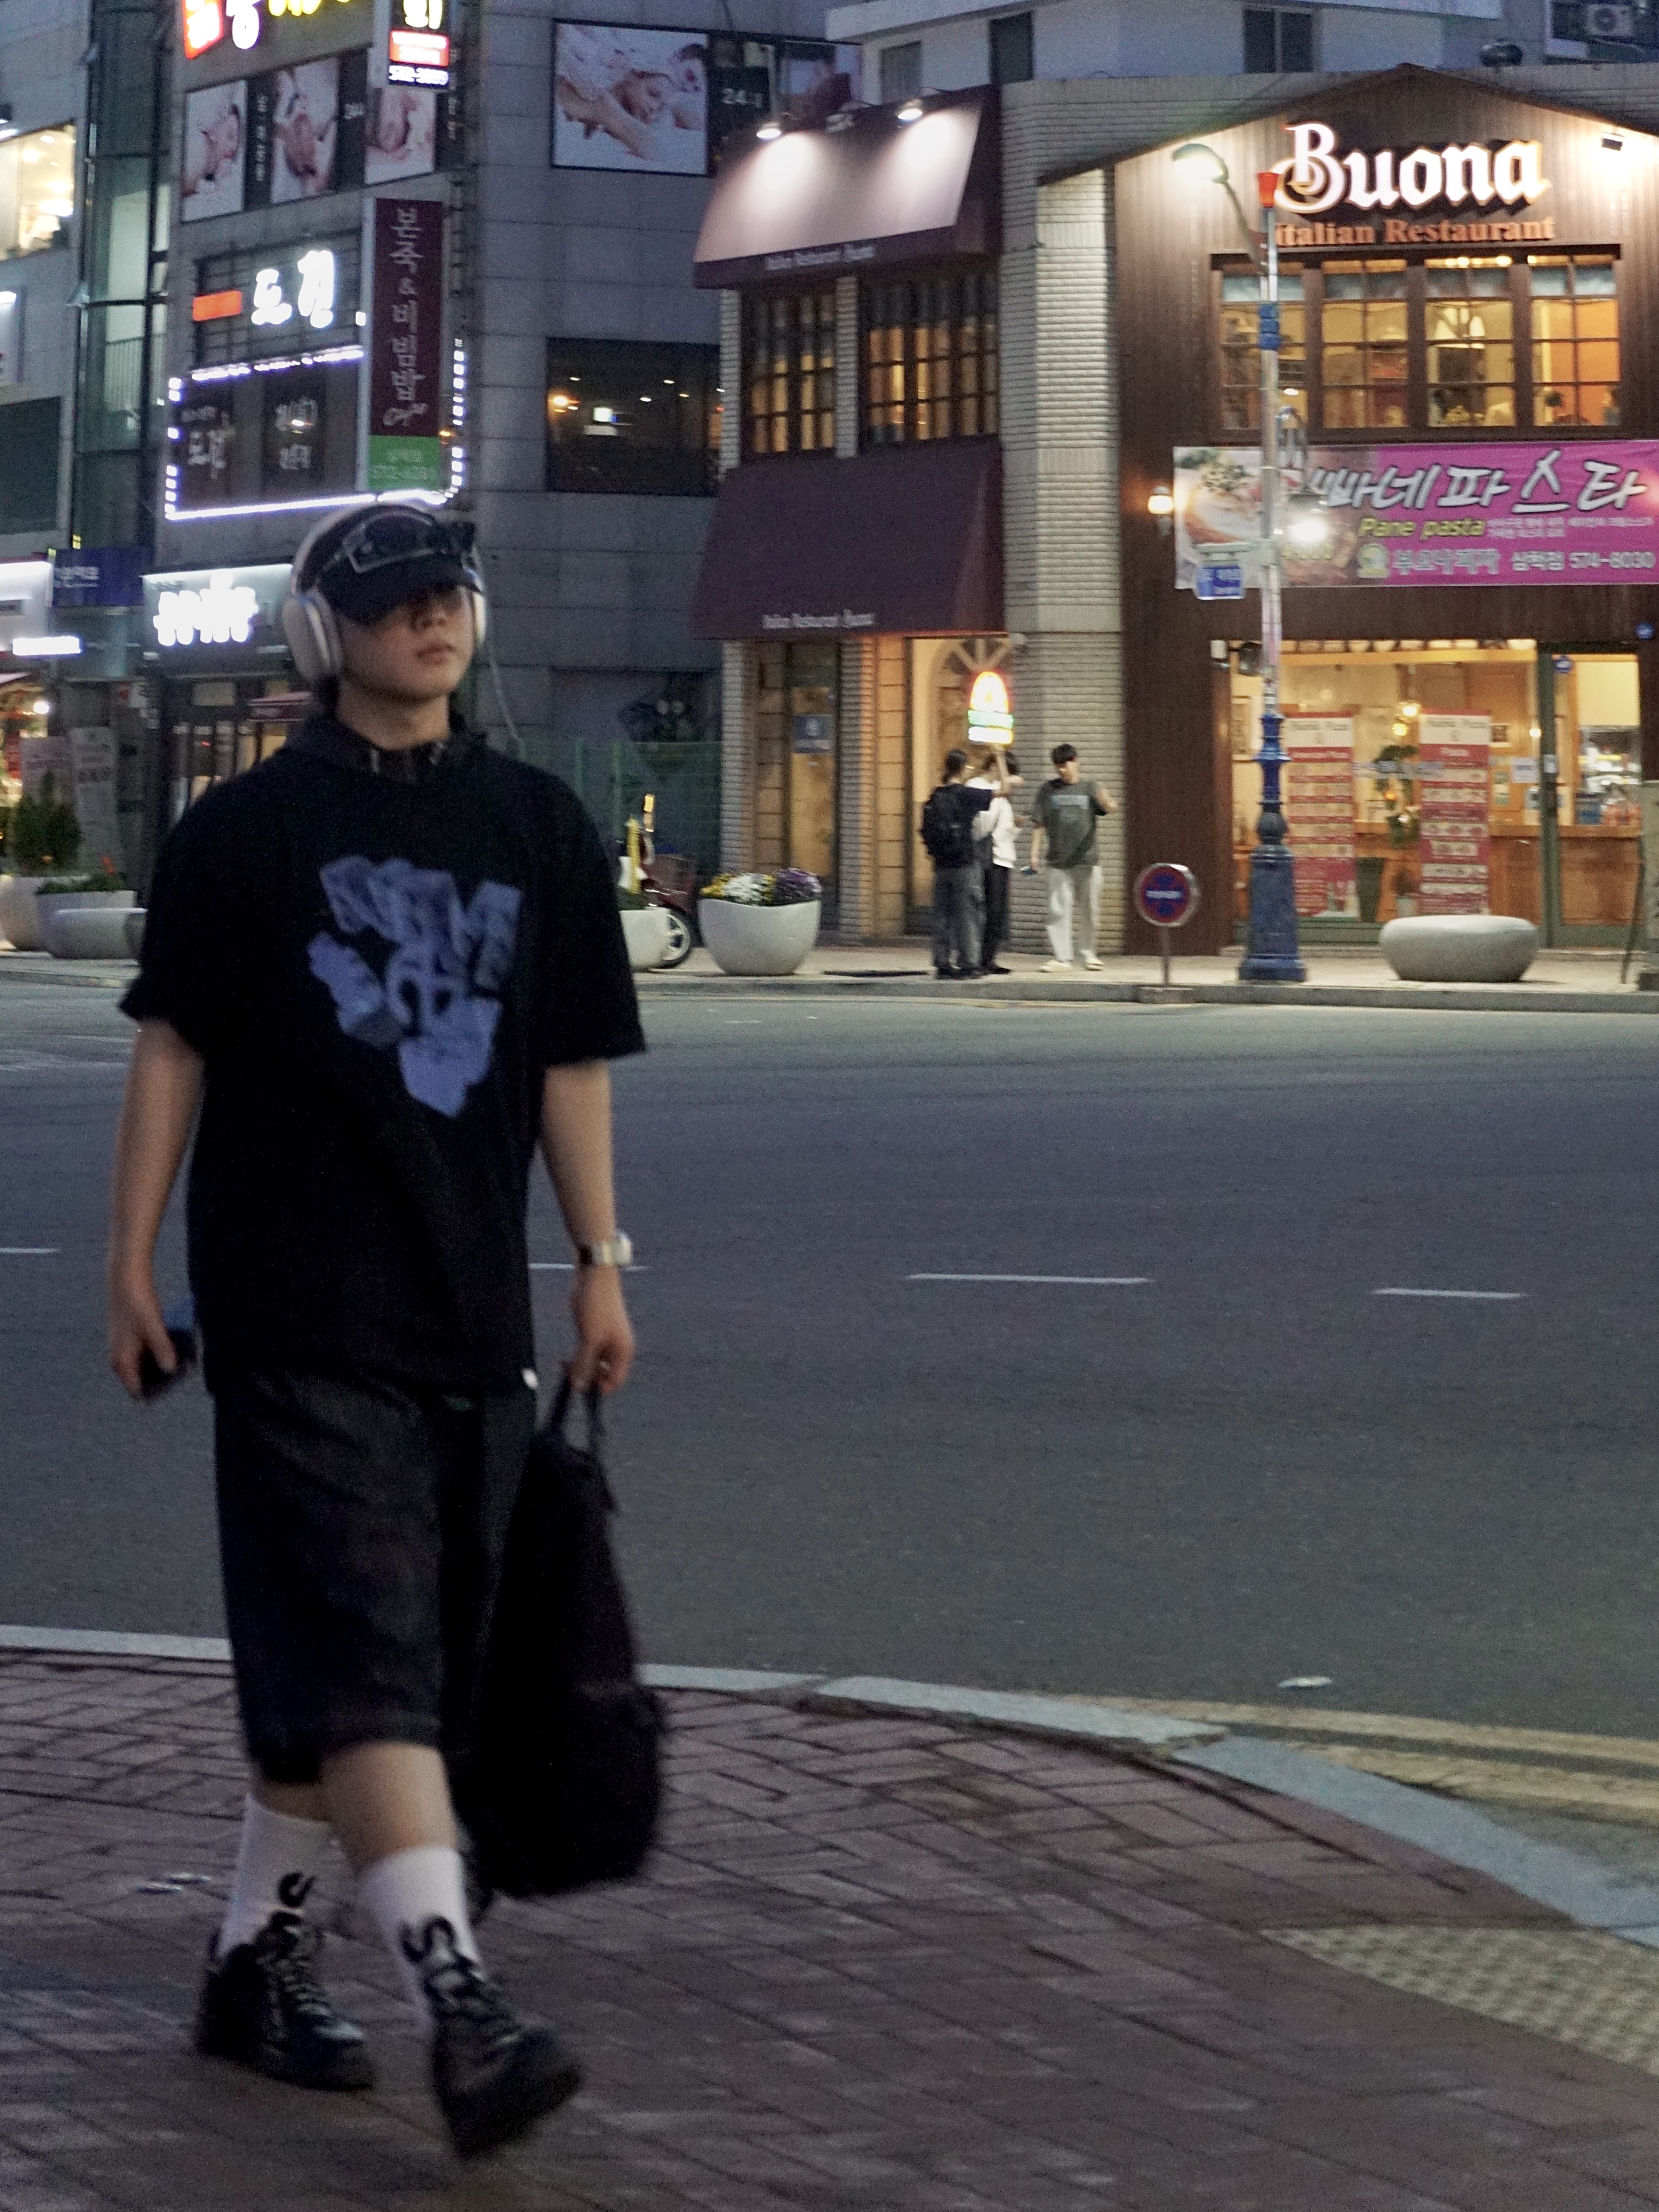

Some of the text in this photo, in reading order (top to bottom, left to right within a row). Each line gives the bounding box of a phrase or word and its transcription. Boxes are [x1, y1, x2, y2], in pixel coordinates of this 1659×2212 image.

[1270, 121, 1552, 215] Buona
[1275, 217, 1555, 246] Italian Restaurant
[1357, 517, 1415, 537] Pane
[1420, 517, 1486, 542] pasta
